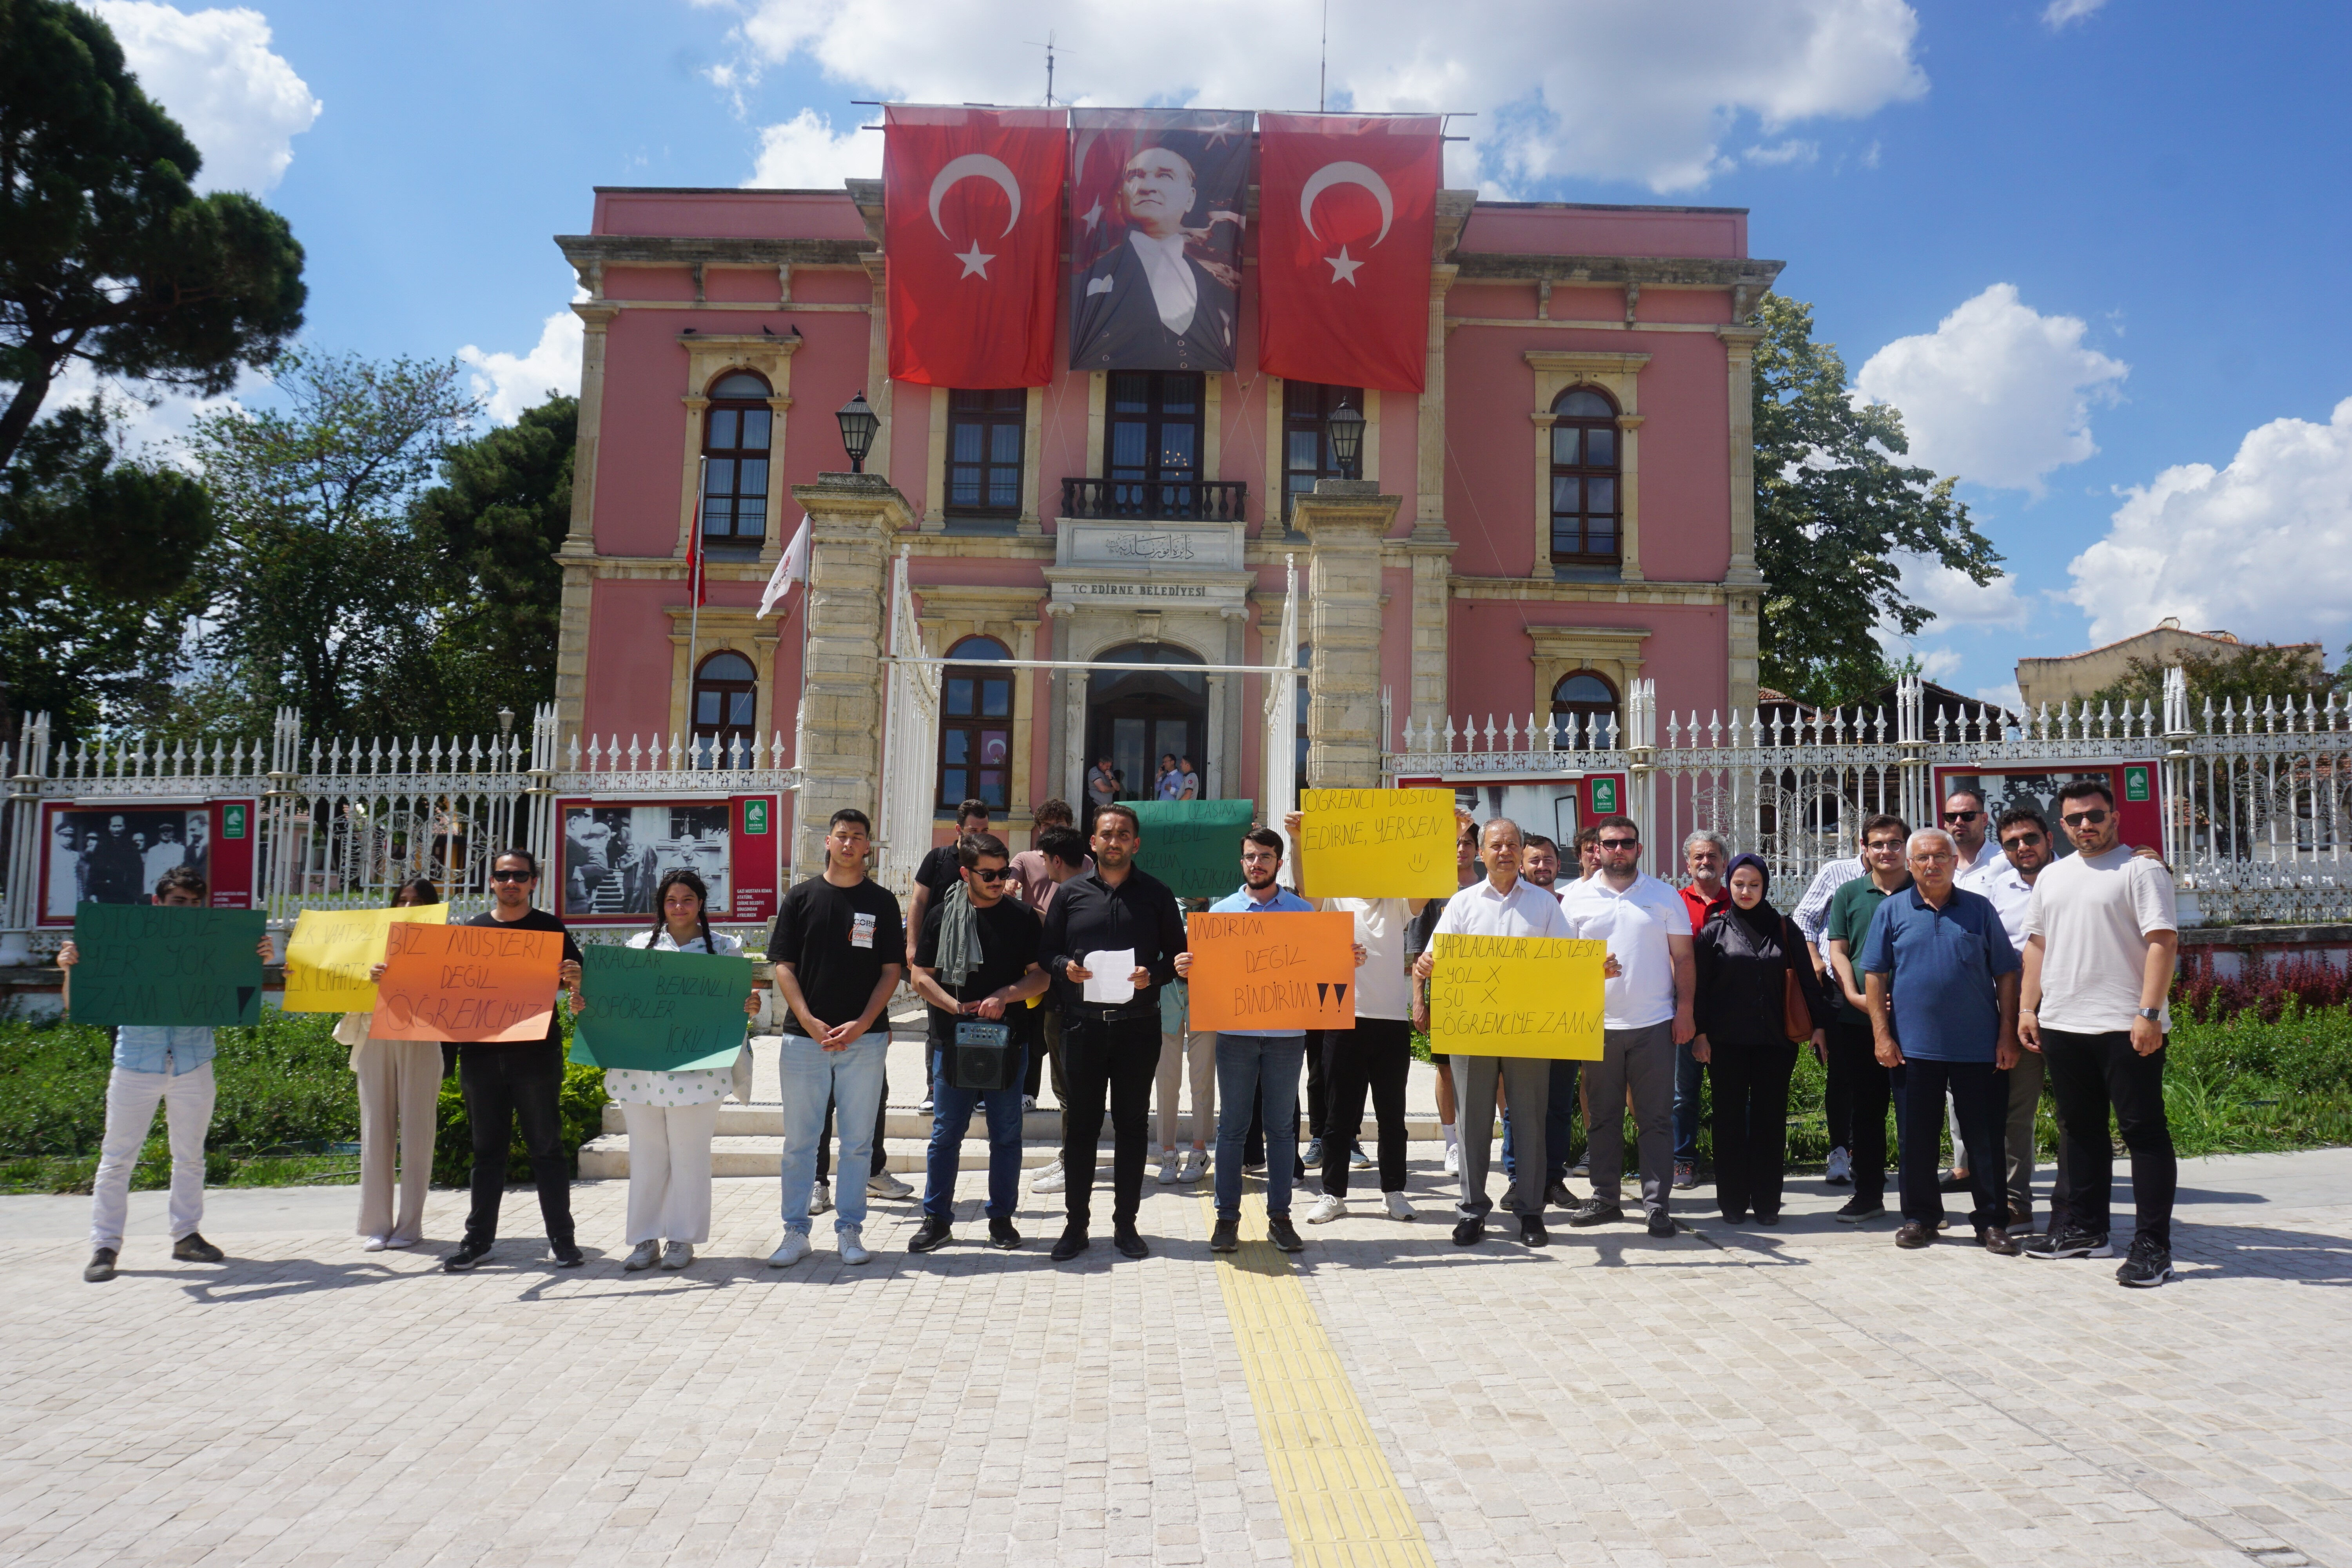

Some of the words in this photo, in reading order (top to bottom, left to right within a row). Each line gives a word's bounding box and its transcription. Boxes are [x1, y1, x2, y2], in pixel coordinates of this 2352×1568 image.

[1071, 584, 1087, 593] TC
[1091, 583, 1134, 595] EDİRNE
[1139, 585, 1205, 597] BELEDİYESİ
[1389, 789, 1437, 807] DOSTU
[1189, 804, 1236, 820] ULAŞIM
[1163, 821, 1209, 845] DEĞİL
[1305, 822, 1367, 851] EDİRNE,
[1374, 816, 1443, 844] YERSEN
[853, 919, 875, 928] CORE
[1193, 915, 1264, 941] İNDİRİM
[388, 924, 426, 956] BİZ
[446, 928, 545, 960] MÜŞTERİ
[1433, 934, 1528, 959] YAPILACAKLAR
[1534, 938, 1602, 959] LİSTESİ:
[82, 945, 140, 979] YER
[160, 945, 217, 977] YOK
[586, 947, 662, 971] ARAÇLAR
[1246, 944, 1307, 973] DEĞİL
[441, 965, 499, 989] DEĞİL
[77, 985, 158, 1019] ZAM
[387, 989, 543, 1031] ÖĞRENCİYİZ
[586, 993, 676, 1022] ŞOFÖRLER
[1537, 1011, 1584, 1034] ZAM
[666, 1024, 721, 1056] İÇKİLİ
